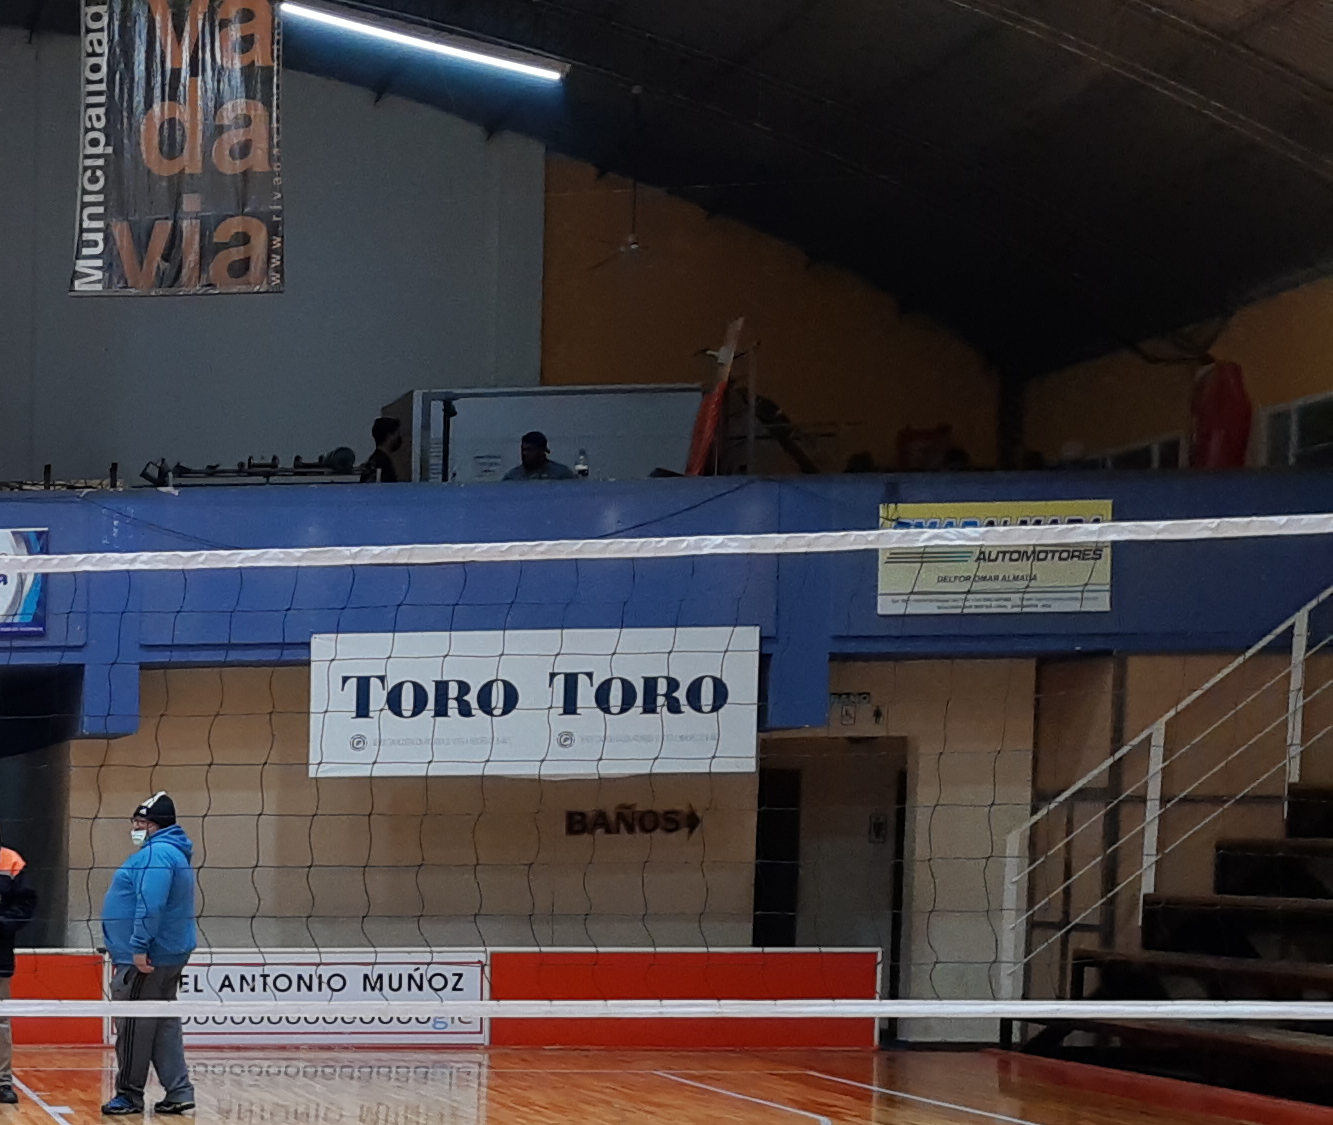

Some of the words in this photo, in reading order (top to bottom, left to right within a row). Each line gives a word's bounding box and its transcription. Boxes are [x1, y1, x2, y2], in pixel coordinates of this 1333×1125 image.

[148, 0, 275, 69] va
[140, 77, 274, 176] da
[111, 193, 269, 291] via
[974, 549, 1103, 563] AUTOMOTORES
[974, 574, 1000, 583] OMAR
[341, 674, 520, 719] TORO
[548, 671, 729, 716] TORO
[564, 803, 680, 836] BAÑOS
[218, 973, 347, 993] ANTONIO
